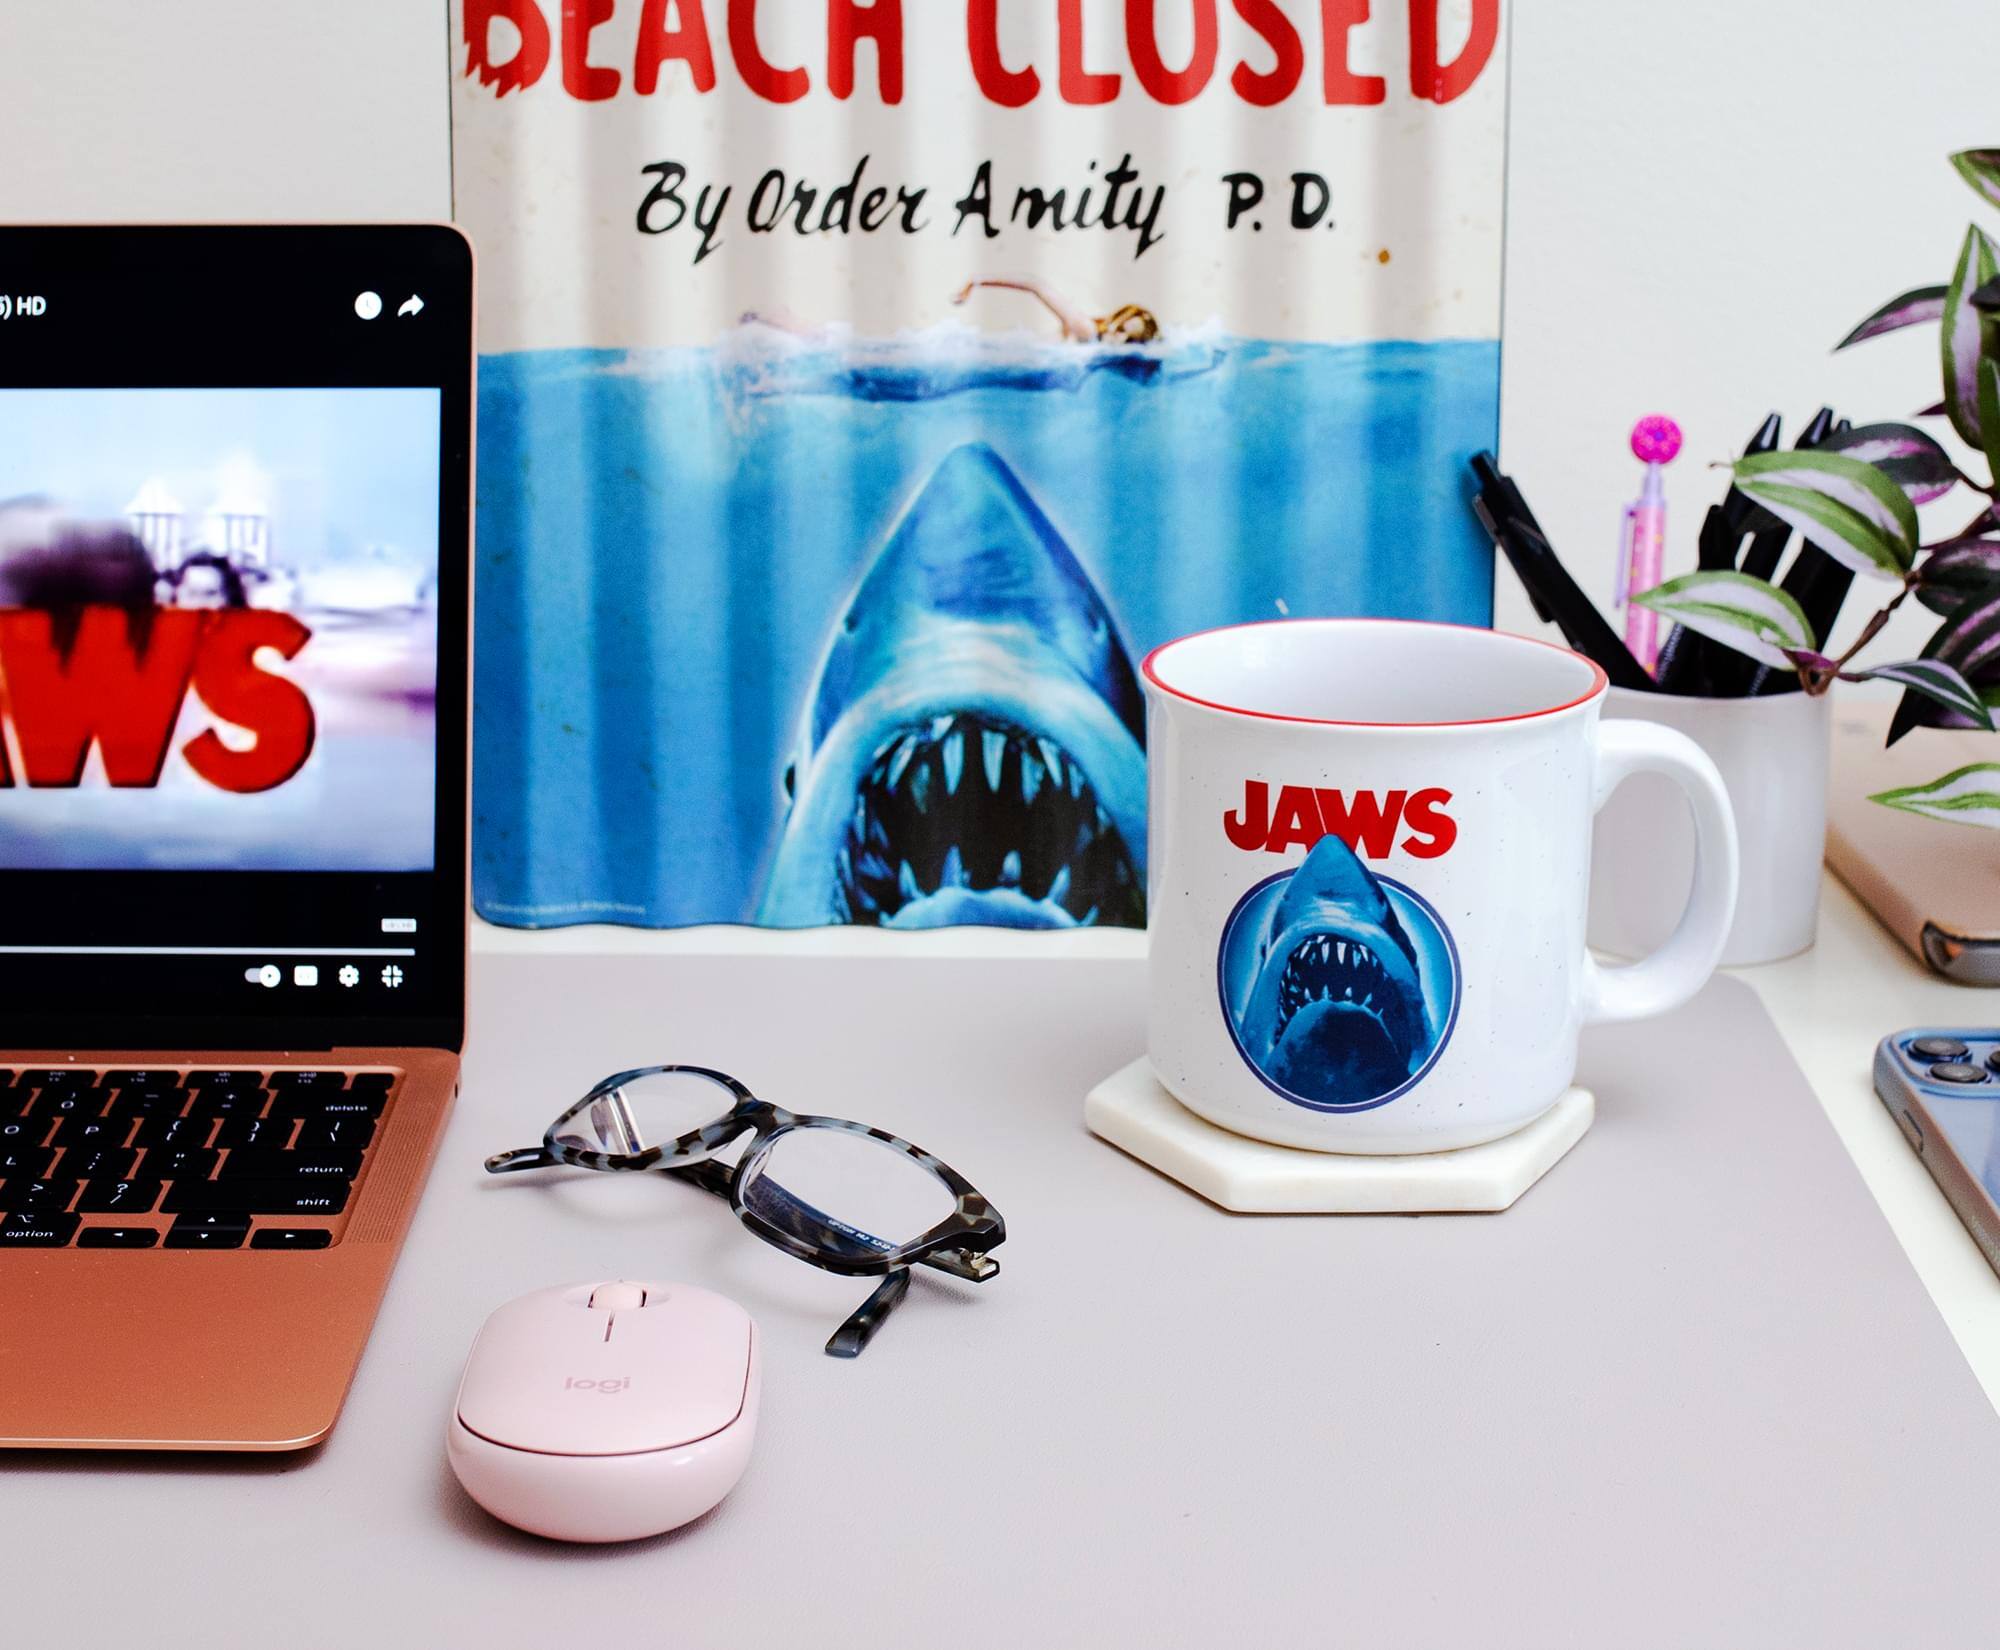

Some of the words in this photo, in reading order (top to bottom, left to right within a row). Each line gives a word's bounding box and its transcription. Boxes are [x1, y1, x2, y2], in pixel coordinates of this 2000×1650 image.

[463, 0, 904, 105] BEACH
[967, 0, 1499, 107] CLOSED
[636, 161, 732, 265] By
[747, 154, 930, 235] Order
[952, 153, 1166, 261] Amity
[16, 295, 47, 316] HD
[0, 604, 315, 793] WS
[1223, 779, 1458, 859] JAWS
[325, 1103, 369, 1112] delete
[296, 1198, 331, 1206] shift
[6, 1230, 54, 1238] option
[565, 1376, 631, 1394] logi
